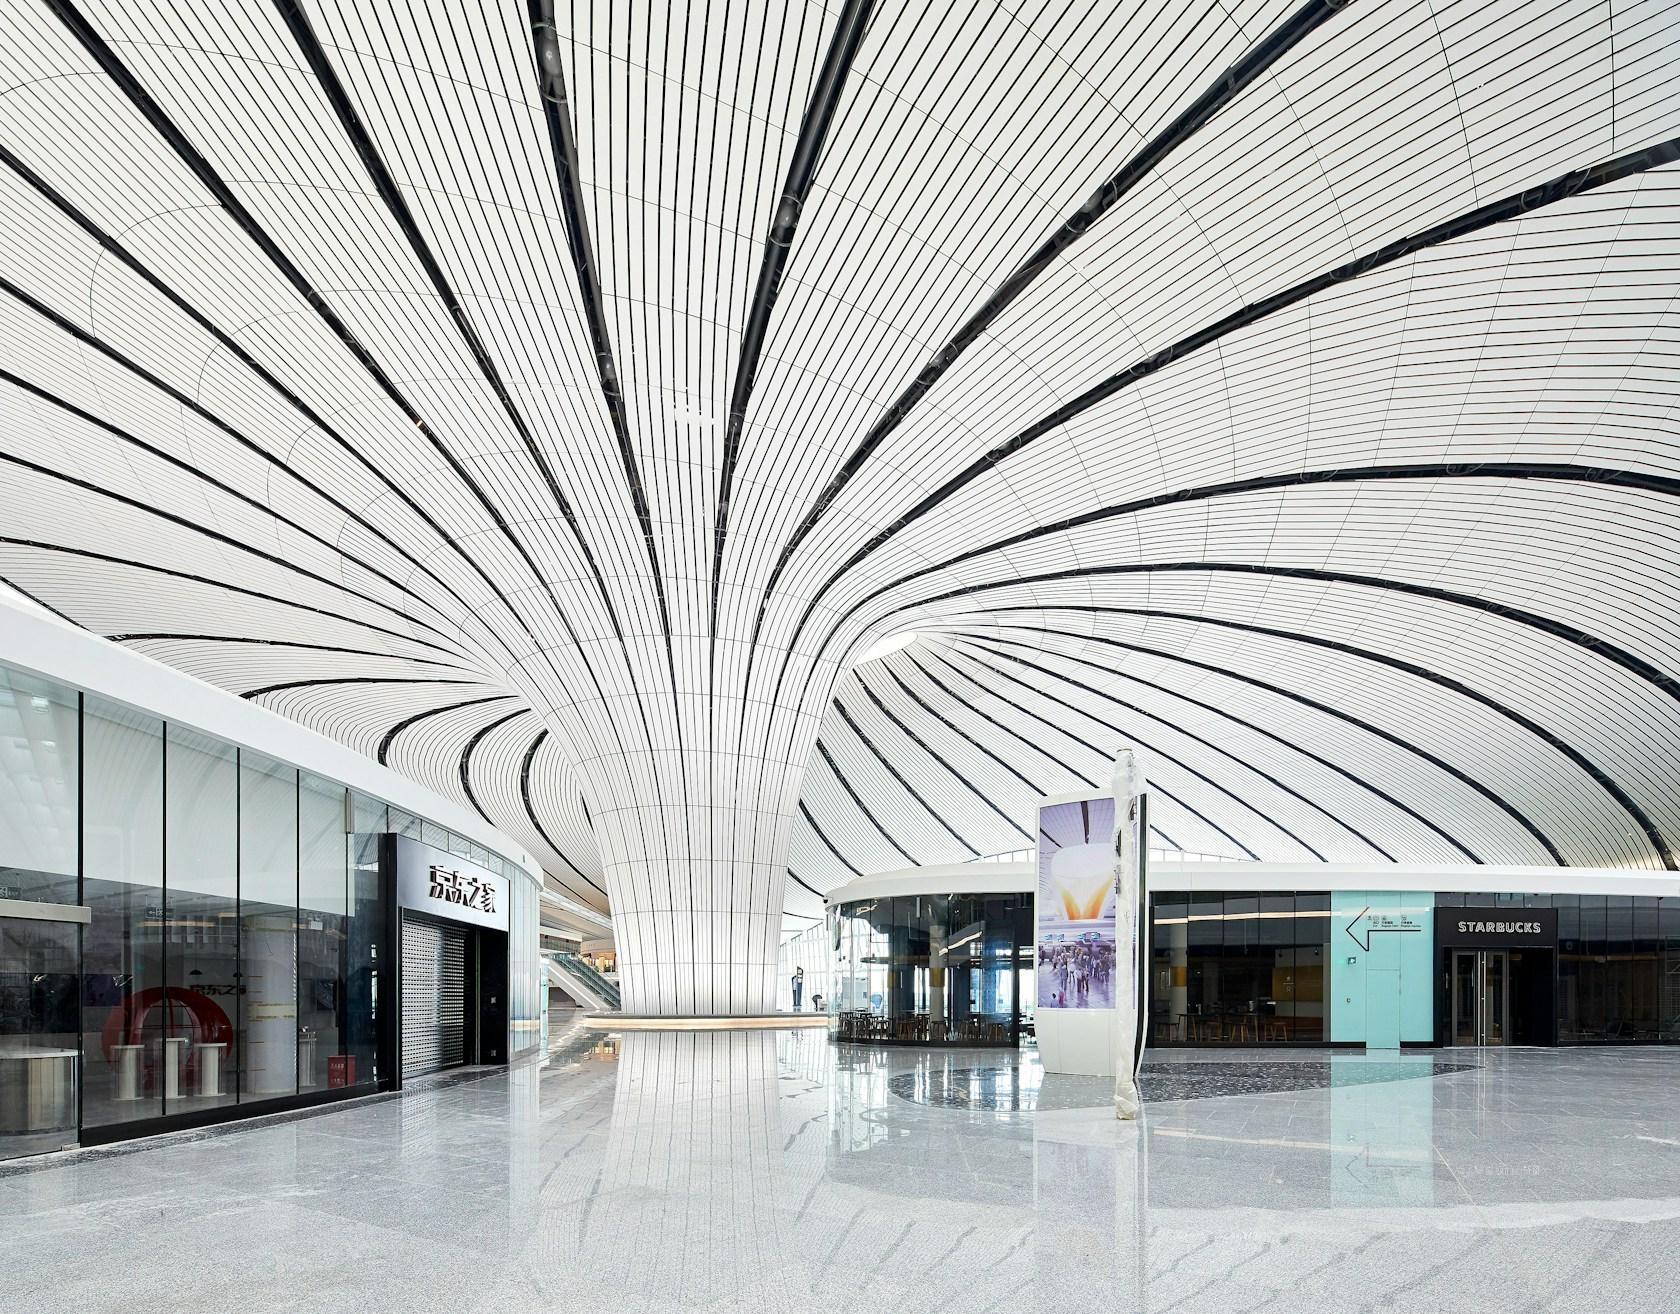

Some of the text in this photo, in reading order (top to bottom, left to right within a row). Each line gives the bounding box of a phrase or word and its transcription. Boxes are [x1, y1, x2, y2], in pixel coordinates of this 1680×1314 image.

[429, 865, 496, 913] 京东之家
[1458, 921, 1541, 934] STARBUCKS
